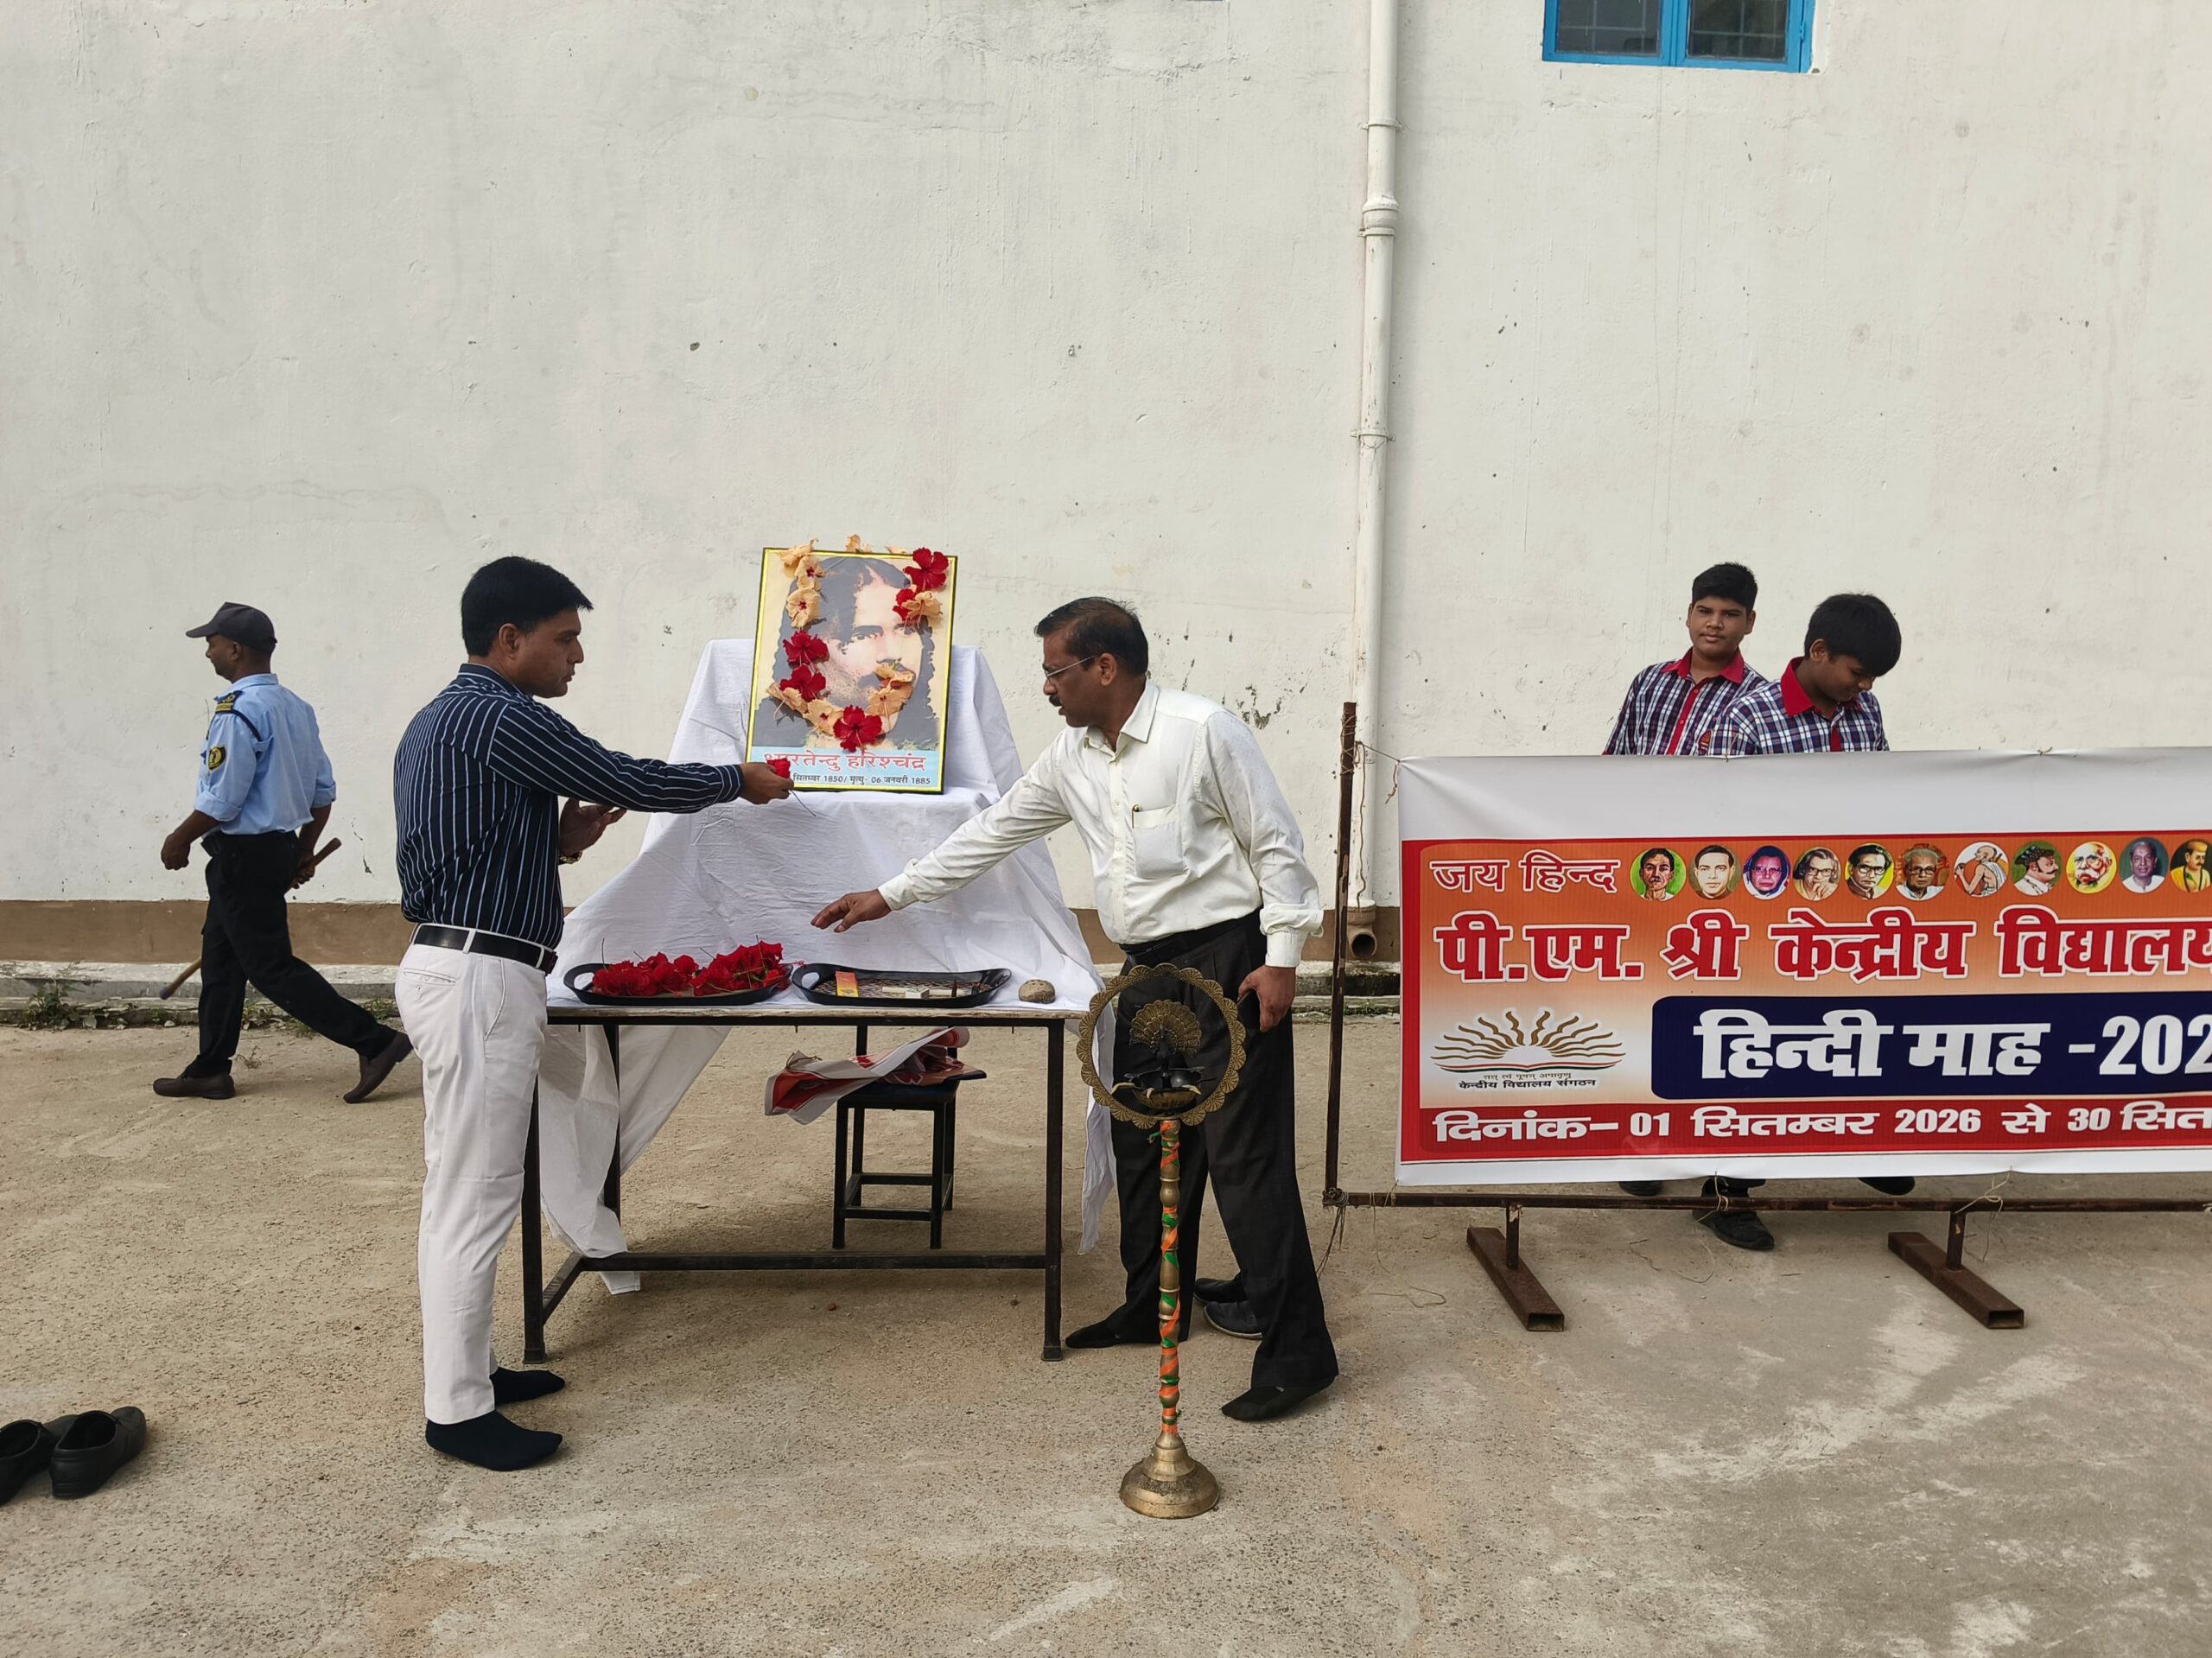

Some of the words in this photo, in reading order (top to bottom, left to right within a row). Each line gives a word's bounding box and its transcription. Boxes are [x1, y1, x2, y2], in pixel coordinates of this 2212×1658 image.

[884, 775, 908, 785] जनवरी
[1430, 860, 1510, 893] जय
[1519, 849, 1621, 893] हिन्द
[1433, 911, 1645, 982] पी.एम.
[1660, 908, 1749, 981] श्री
[1768, 906, 1977, 984] केन्द्रीय
[1693, 1008, 1894, 1078] हिन्दी
[1902, 1023, 2051, 1077] माह
[1503, 1080, 1551, 1089] विद्यालय
[1630, 1112, 1670, 1137] 01
[1690, 1106, 1880, 1137] सितम्बर
[1894, 1109, 1981, 1134] 2026
[2001, 1102, 2051, 1134] से
[2067, 1107, 2112, 1132] 30
